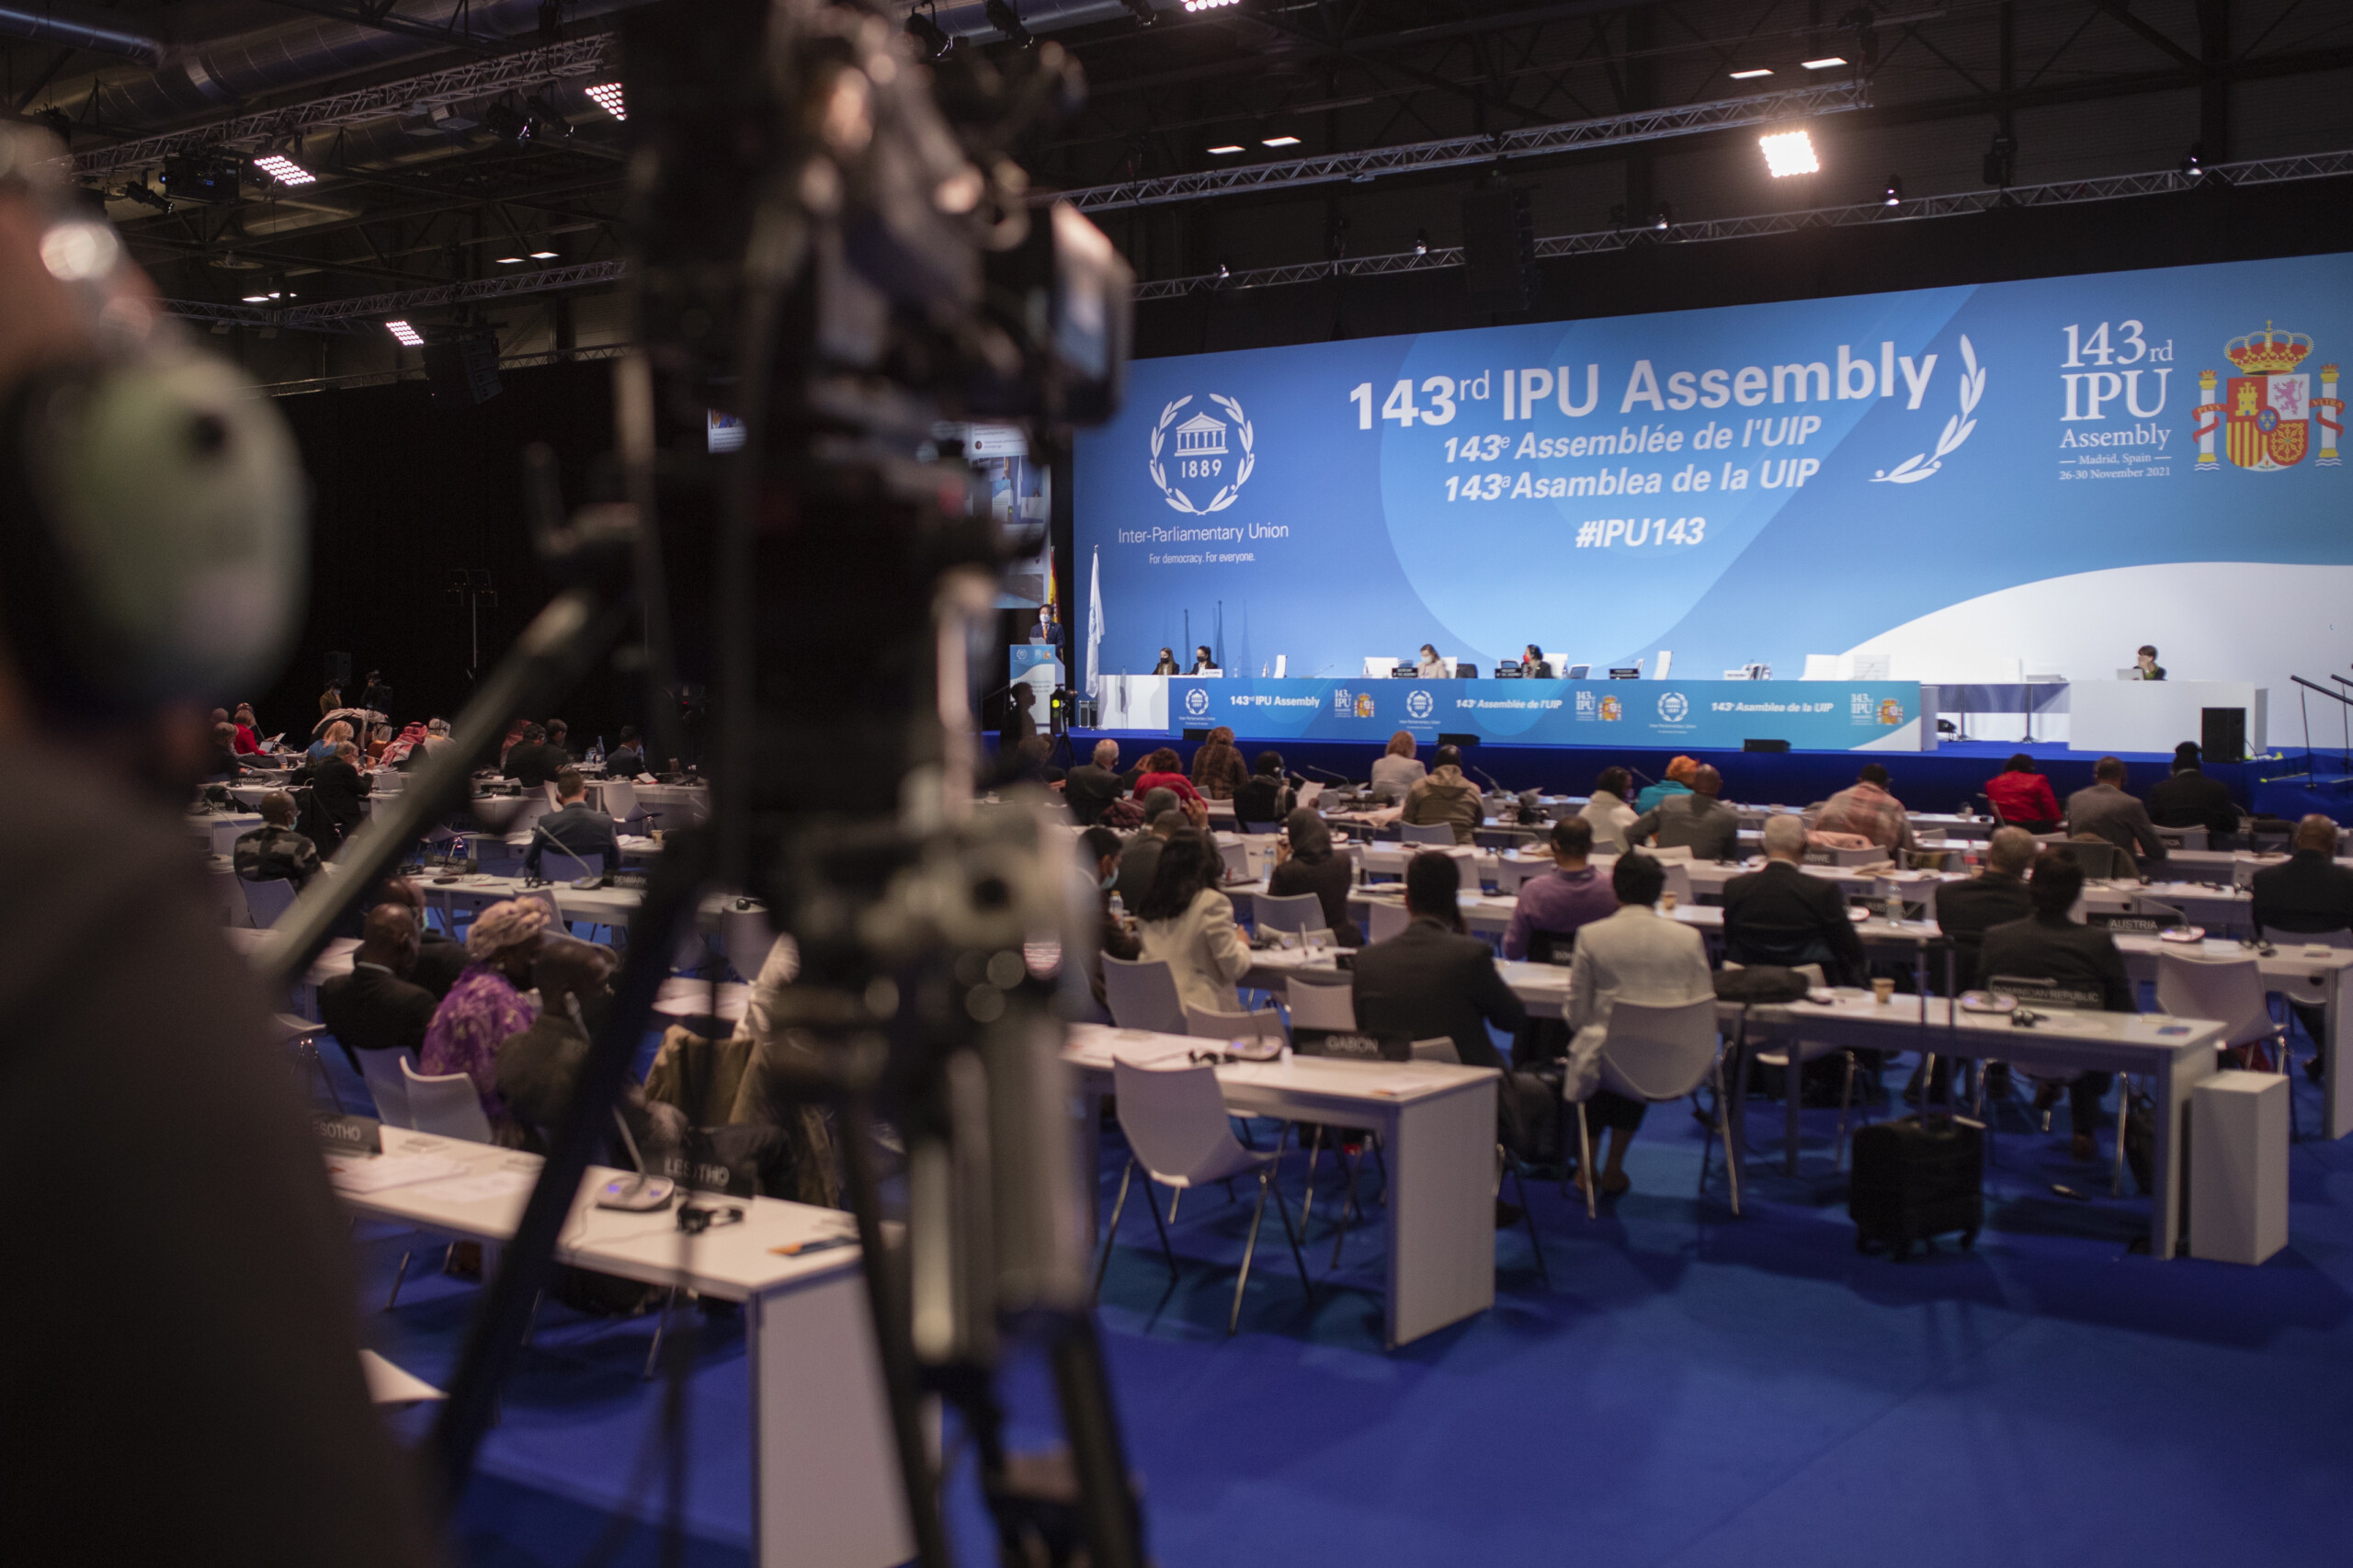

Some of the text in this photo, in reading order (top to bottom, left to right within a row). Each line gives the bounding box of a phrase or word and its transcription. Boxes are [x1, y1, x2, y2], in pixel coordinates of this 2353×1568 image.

[2060, 319, 2174, 368] 143rd
[1349, 341, 1938, 430] 143rd IPU Assembly
[2060, 368, 2173, 422] IPU
[1514, 423, 1684, 460] Assemblée
[1692, 421, 1733, 450] de
[1742, 415, 1822, 448] l'UIP
[2060, 423, 2172, 450] Assembly
[2079, 452, 2152, 465] Madrid, Spain
[1181, 459, 1222, 478] 1889
[2059, 466, 2170, 480] 26-30 November 2021
[1510, 468, 1661, 500] Asamblea
[1671, 464, 1711, 493] de
[1720, 461, 1748, 491] la
[1759, 458, 1821, 489] UIP
[1119, 522, 1289, 544] Inter-Parliamentary Union
[1575, 517, 1706, 549] #IPU143
[1149, 551, 1256, 564] For democracy. For everyone.
[1256, 696, 1272, 706] IPU
[1274, 696, 1321, 708] Assembly
[1527, 699, 1539, 709] de
[1787, 702, 1802, 712] de
[1803, 702, 1813, 712] la
[1813, 702, 1835, 712] UIP
[613, 874, 648, 884] DENMARK
[2110, 918, 2158, 930] AUSTRIA
[1993, 983, 2099, 1002] DOMINICAN REPUBLIC
[1325, 1034, 1379, 1053] GABON
